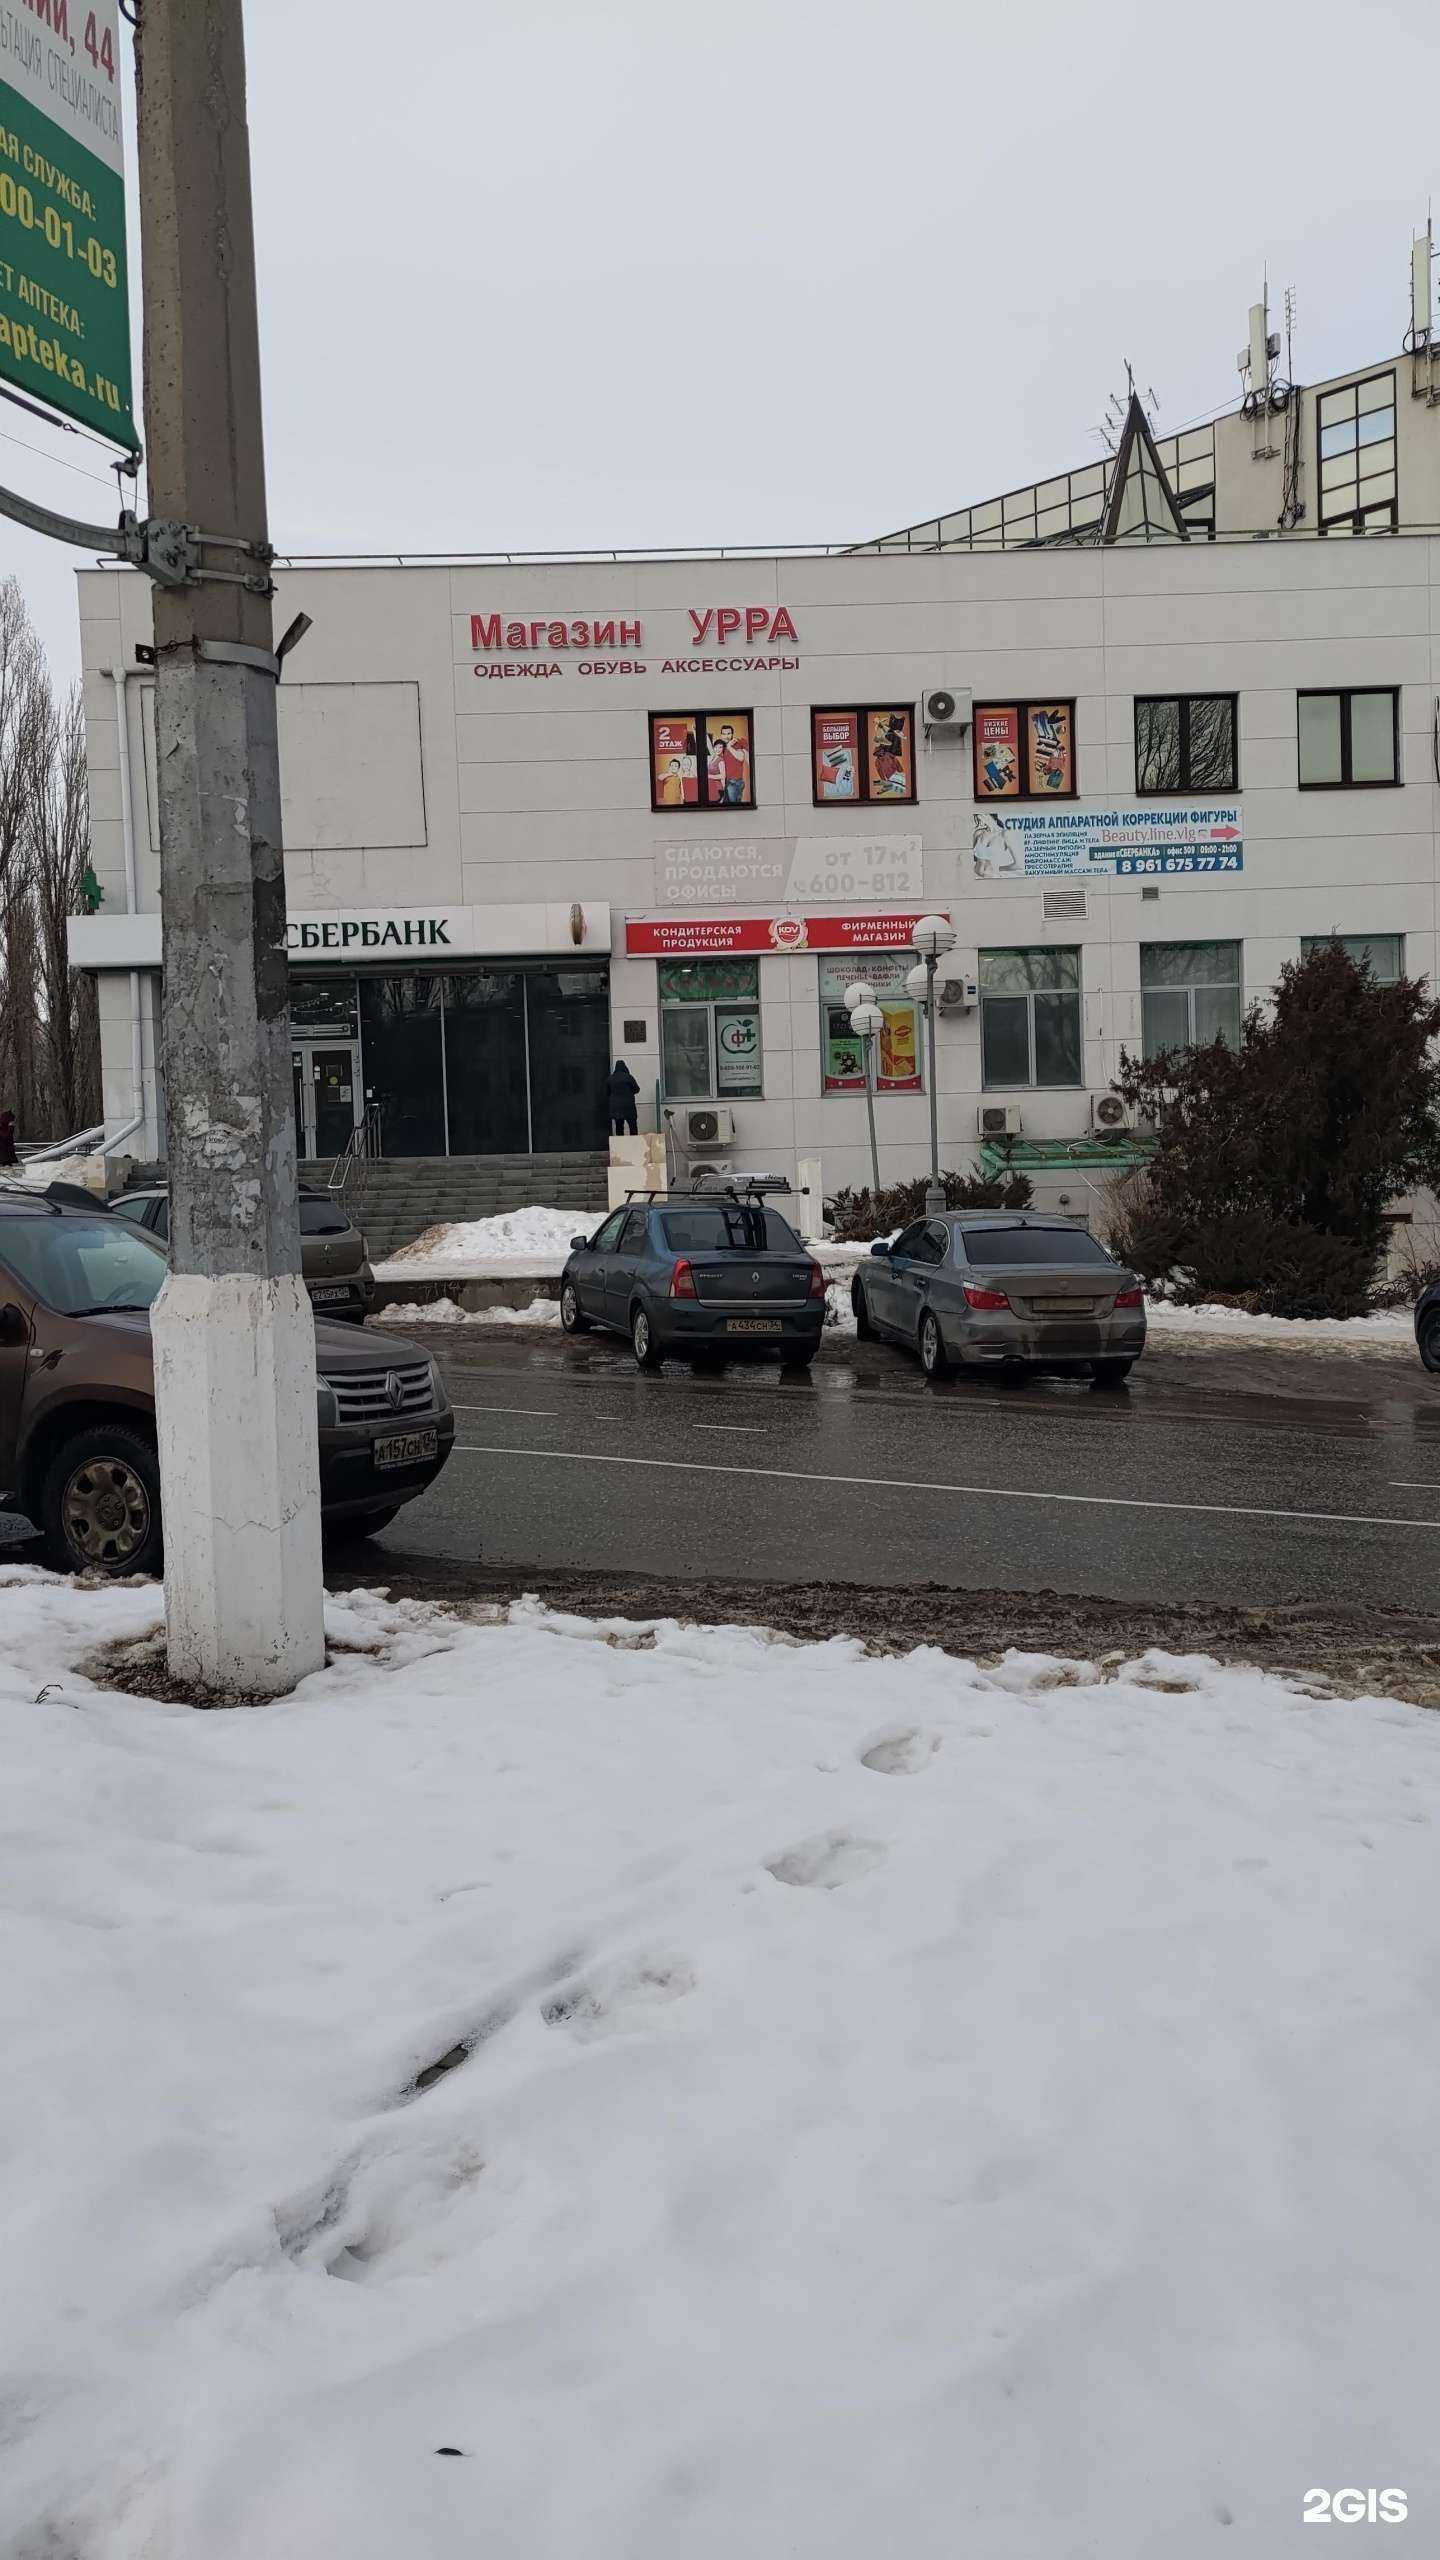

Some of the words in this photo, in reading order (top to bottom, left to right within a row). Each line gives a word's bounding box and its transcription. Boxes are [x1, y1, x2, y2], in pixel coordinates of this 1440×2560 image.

[84, 9, 114, 84] 44
[47, 48, 120, 144] СПЕЦИАЛИСТА
[23, 144, 97, 222] СЛУЖБА:
[18, 273, 86, 340] АПТЕКА:
[470, 613, 642, 649] Магазин
[687, 606, 799, 645] УРРА
[473, 663, 562, 679] ОДЕЖДА
[577, 661, 647, 676] ОБУВЬ
[660, 657, 800, 673] АКСЕССУАРЫ
[658, 726, 671, 740] 2
[823, 732, 850, 741] ВЫБОР
[984, 726, 1009, 737] ЦЕНЫ
[659, 740, 683, 748] ЭТАЖ
[1004, 816, 1046, 831] СТУДИЯ
[1049, 811, 1119, 829] АППАРАТНОЙ
[1122, 811, 1188, 827] КОРРЕКЦИИ
[1190, 810, 1237, 824] ФИГУРЫ
[664, 846, 762, 864] СДАЮТСЯ,
[824, 852, 852, 866] от
[1167, 846, 1183, 856] офис
[665, 863, 783, 881] ПРОДАЮТСЯ
[1121, 860, 1132, 873] 8
[1135, 859, 1162, 872] 961
[1165, 857, 1194, 871] 675
[1197, 857, 1216, 870] 77
[1219, 856, 1238, 869] 74
[810, 872, 911, 893] 600-812
[666, 884, 737, 899] ОФИСЫ
[653, 926, 742, 937] КОНДИТЕРСКАЯ
[841, 917, 918, 931] ФИРМЕННЫЙ
[286, 919, 451, 949] СБЕРБАНК
[662, 937, 734, 948] ПРОДУКЦИЯ
[852, 932, 906, 942] МАГАЗИН
